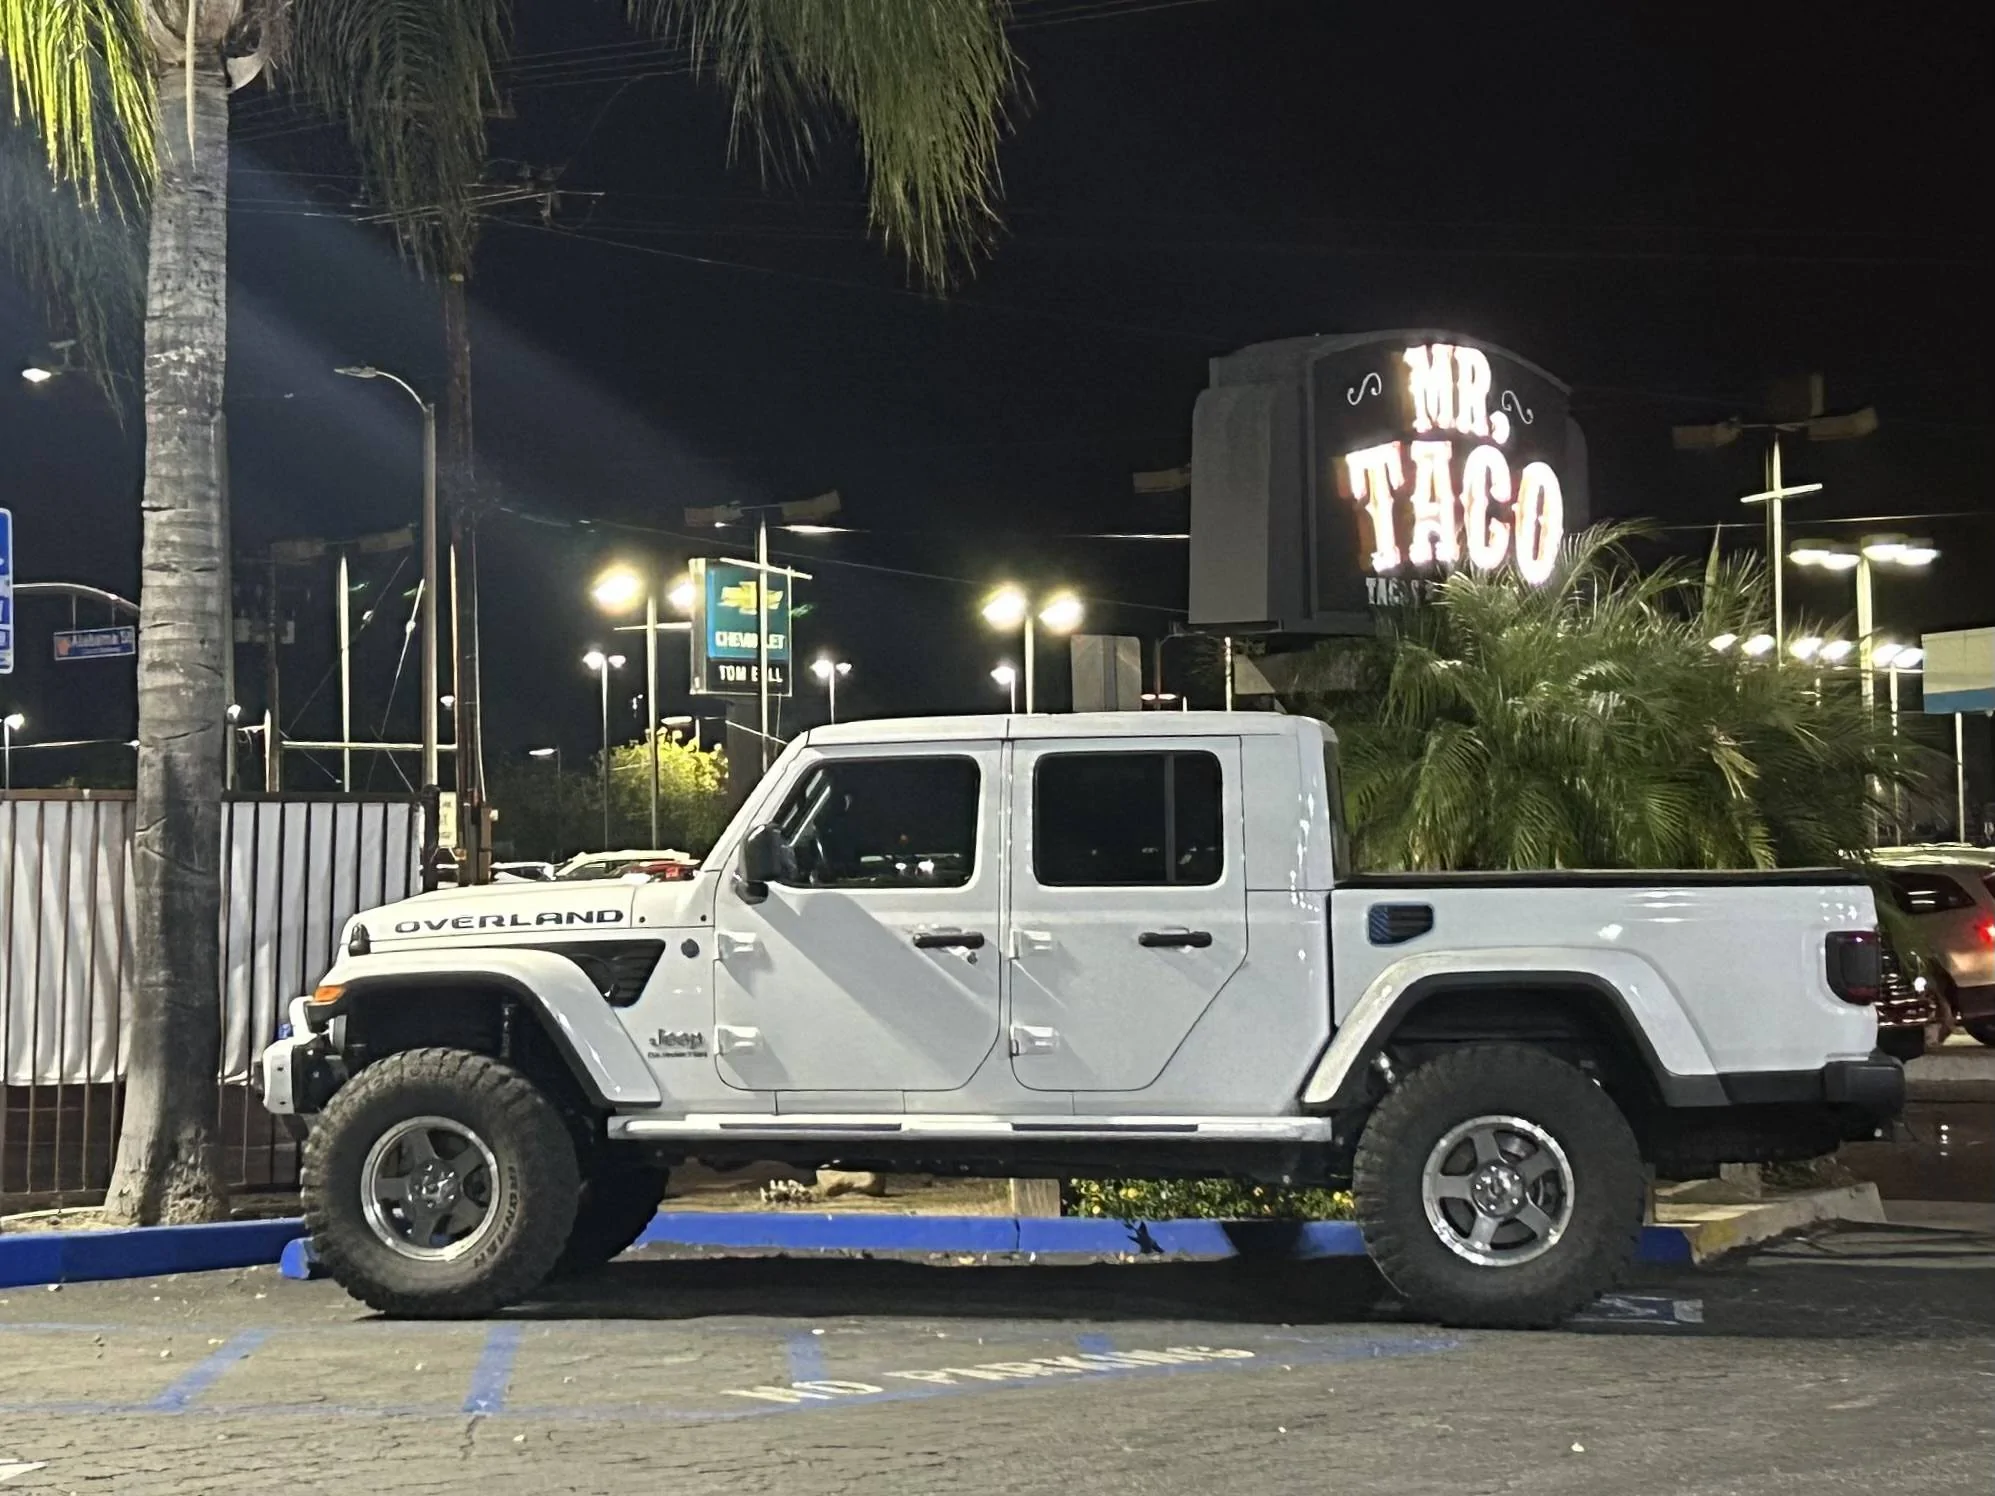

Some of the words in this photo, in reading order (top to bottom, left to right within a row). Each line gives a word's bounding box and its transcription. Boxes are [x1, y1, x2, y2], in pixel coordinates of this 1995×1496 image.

[1403, 343, 1510, 444] MR.
[1345, 440, 1563, 586] TACO
[718, 664, 747, 682] TOM
[395, 909, 624, 933] OVERLAND
[719, 1379, 885, 1403] NO
